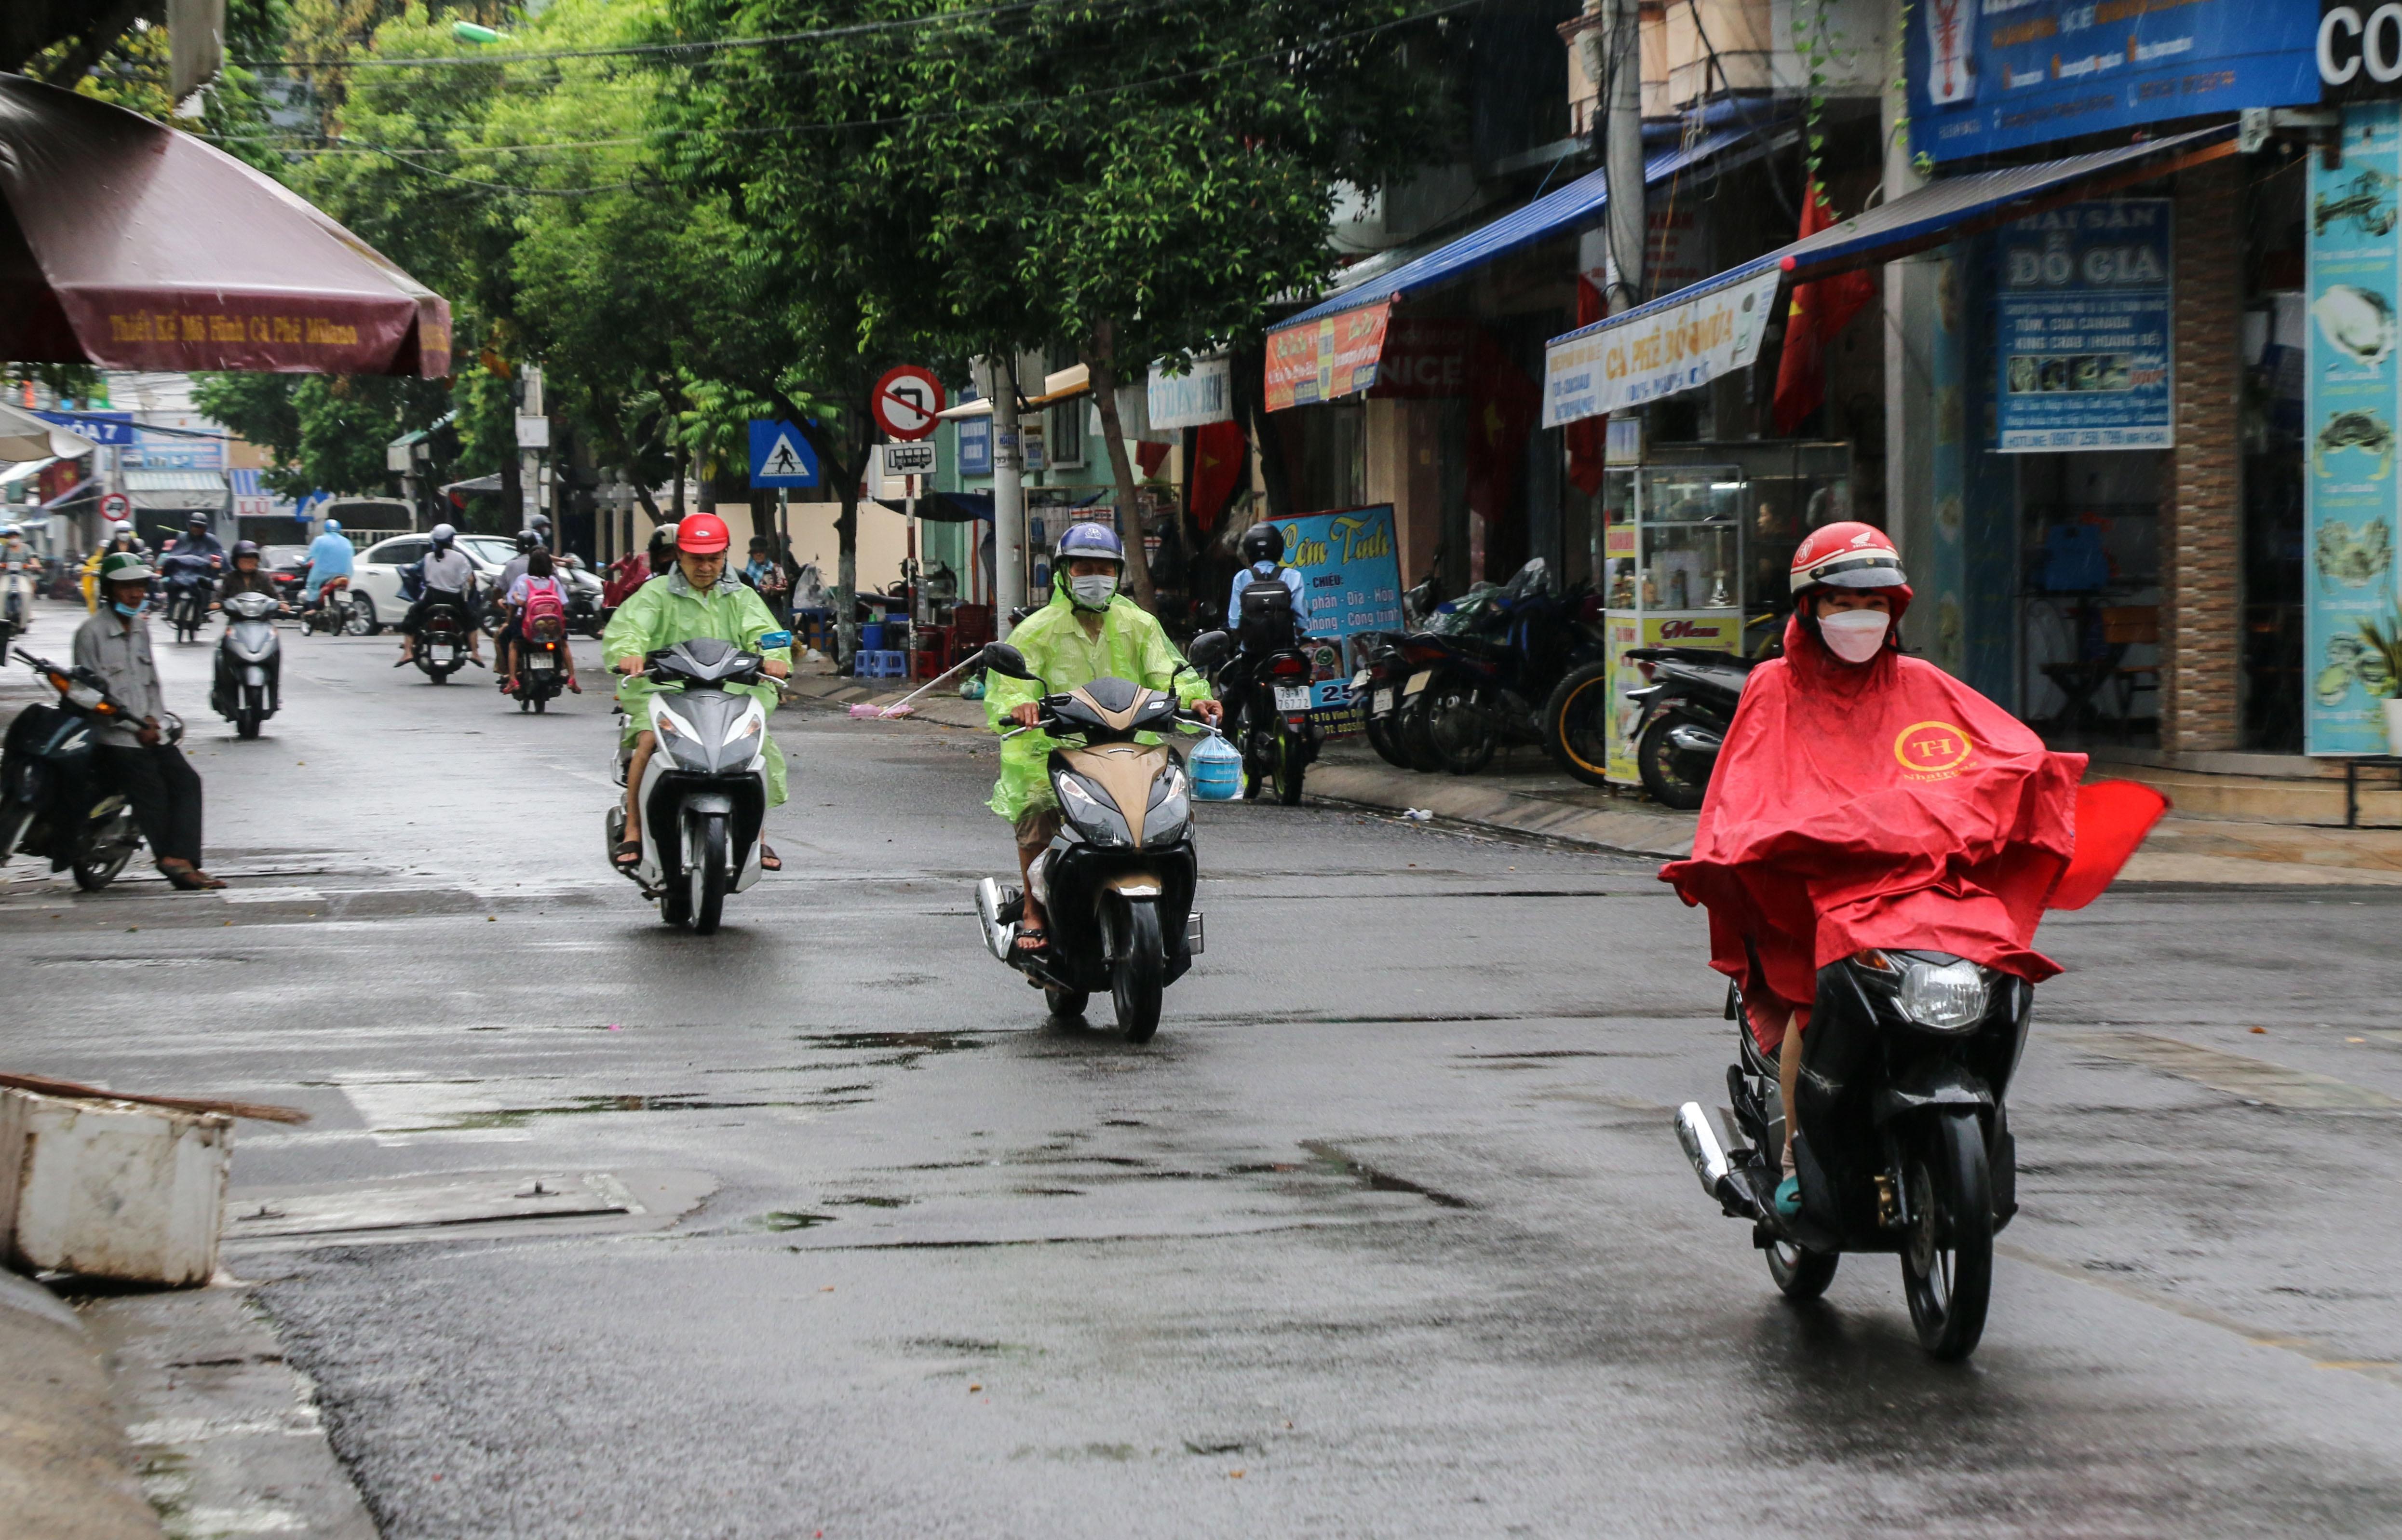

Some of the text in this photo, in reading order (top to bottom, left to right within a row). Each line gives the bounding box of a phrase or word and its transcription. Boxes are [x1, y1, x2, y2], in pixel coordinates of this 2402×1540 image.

[2316, 2, 2402, 86] CO
[2083, 244, 2164, 284] GIA
[1660, 620, 1720, 640] Menu
[1913, 738, 1955, 757] TH
